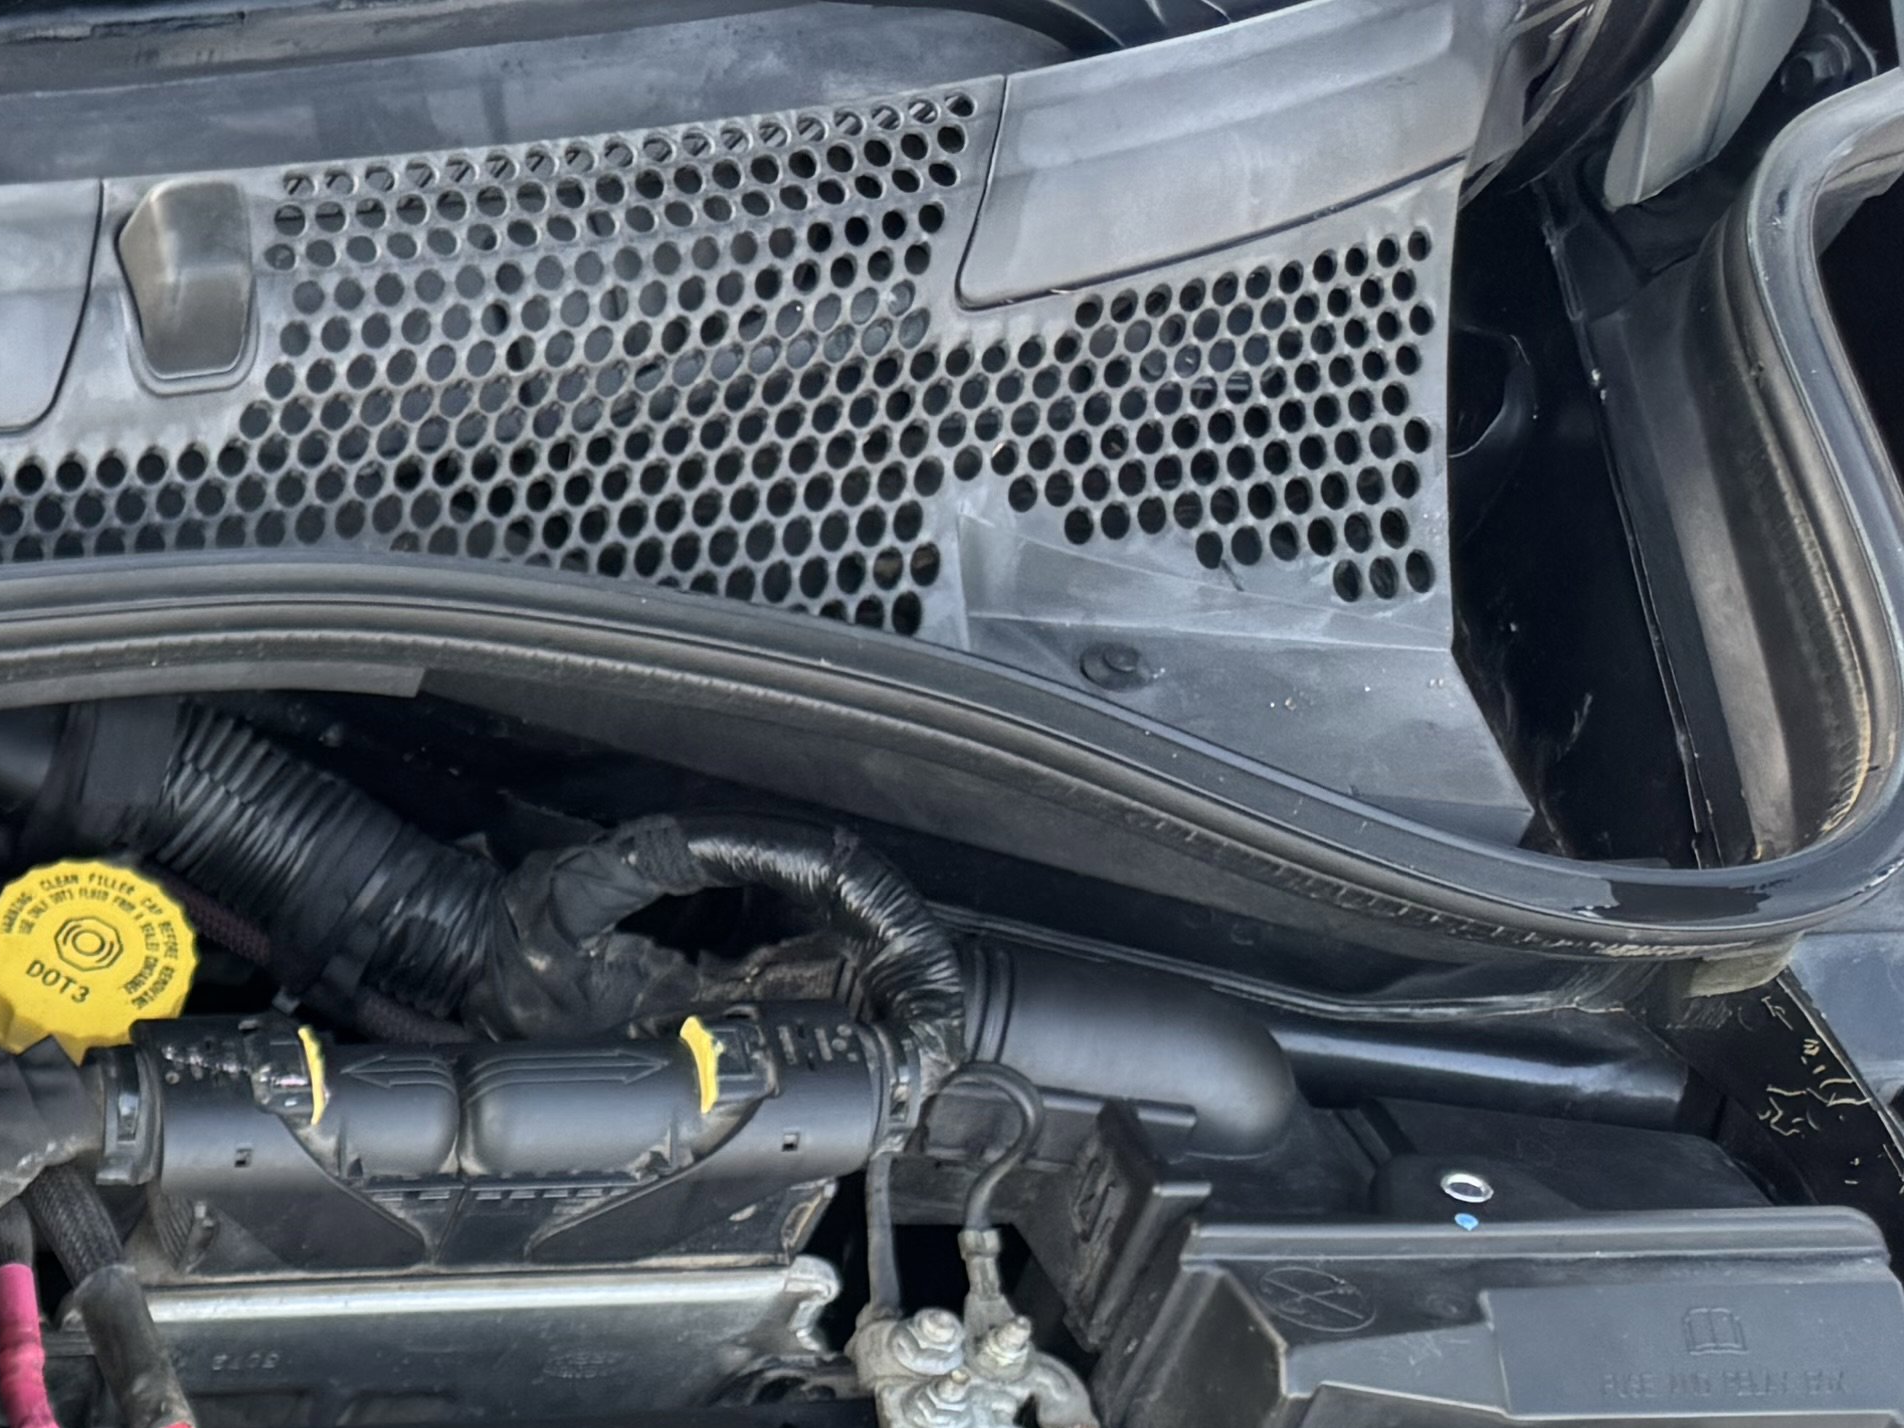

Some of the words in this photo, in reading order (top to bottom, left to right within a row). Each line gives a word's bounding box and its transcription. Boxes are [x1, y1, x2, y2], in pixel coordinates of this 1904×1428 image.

[39, 874, 80, 892] CLEAN
[88, 873, 135, 895] FILLER
[141, 898, 164, 916] CAP
[158, 920, 179, 961] BEFORE
[25, 958, 90, 1003] DOT3
